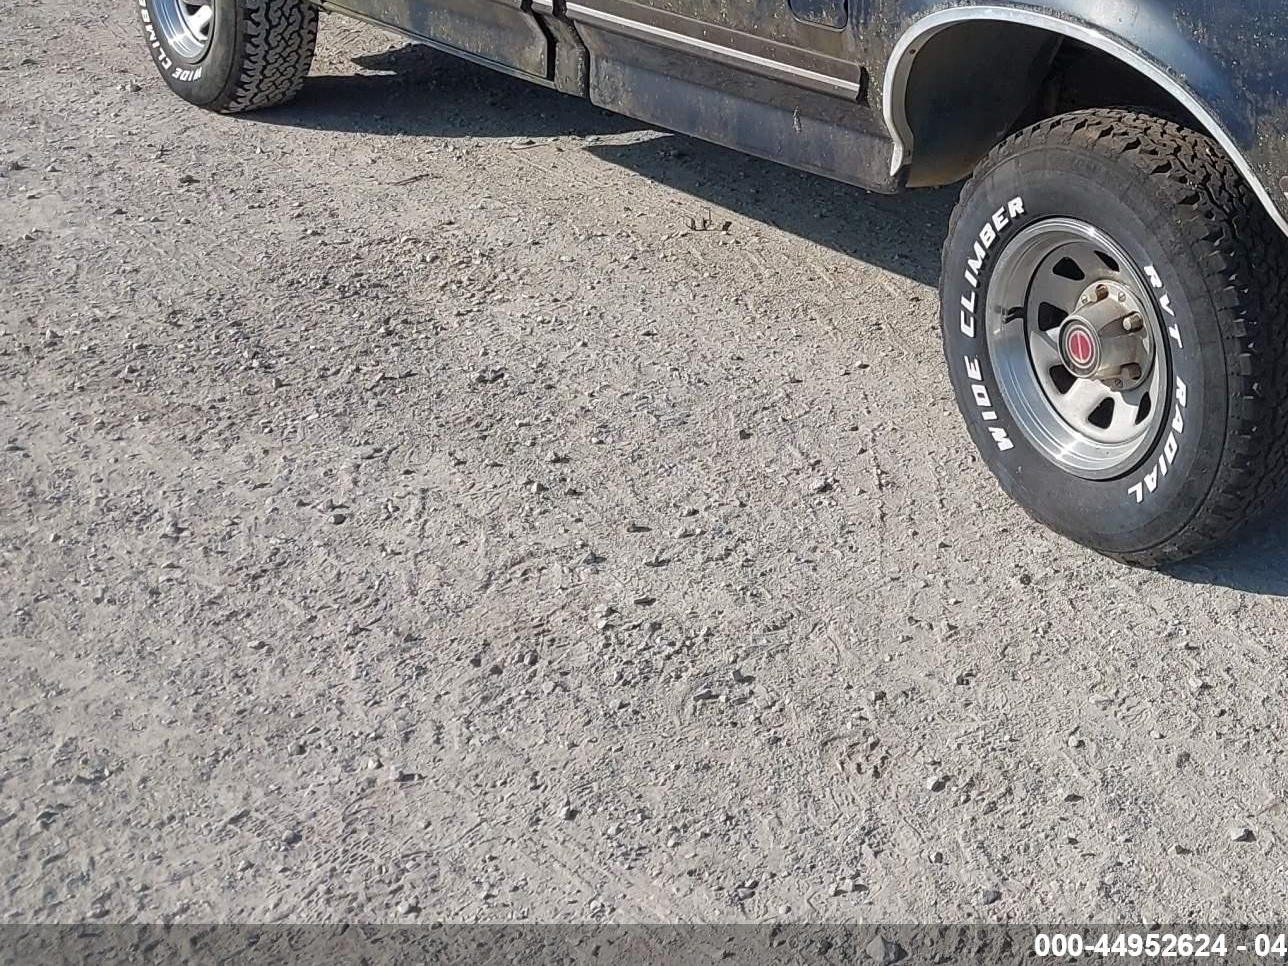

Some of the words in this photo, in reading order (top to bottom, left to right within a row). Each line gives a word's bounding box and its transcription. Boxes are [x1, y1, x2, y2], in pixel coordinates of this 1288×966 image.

[172, 66, 203, 83] WIDE
[961, 196, 1025, 338] CLIMBER
[1144, 265, 1183, 348] RVT
[964, 355, 1014, 451] WIDE
[1128, 376, 1187, 503] RADIAL
